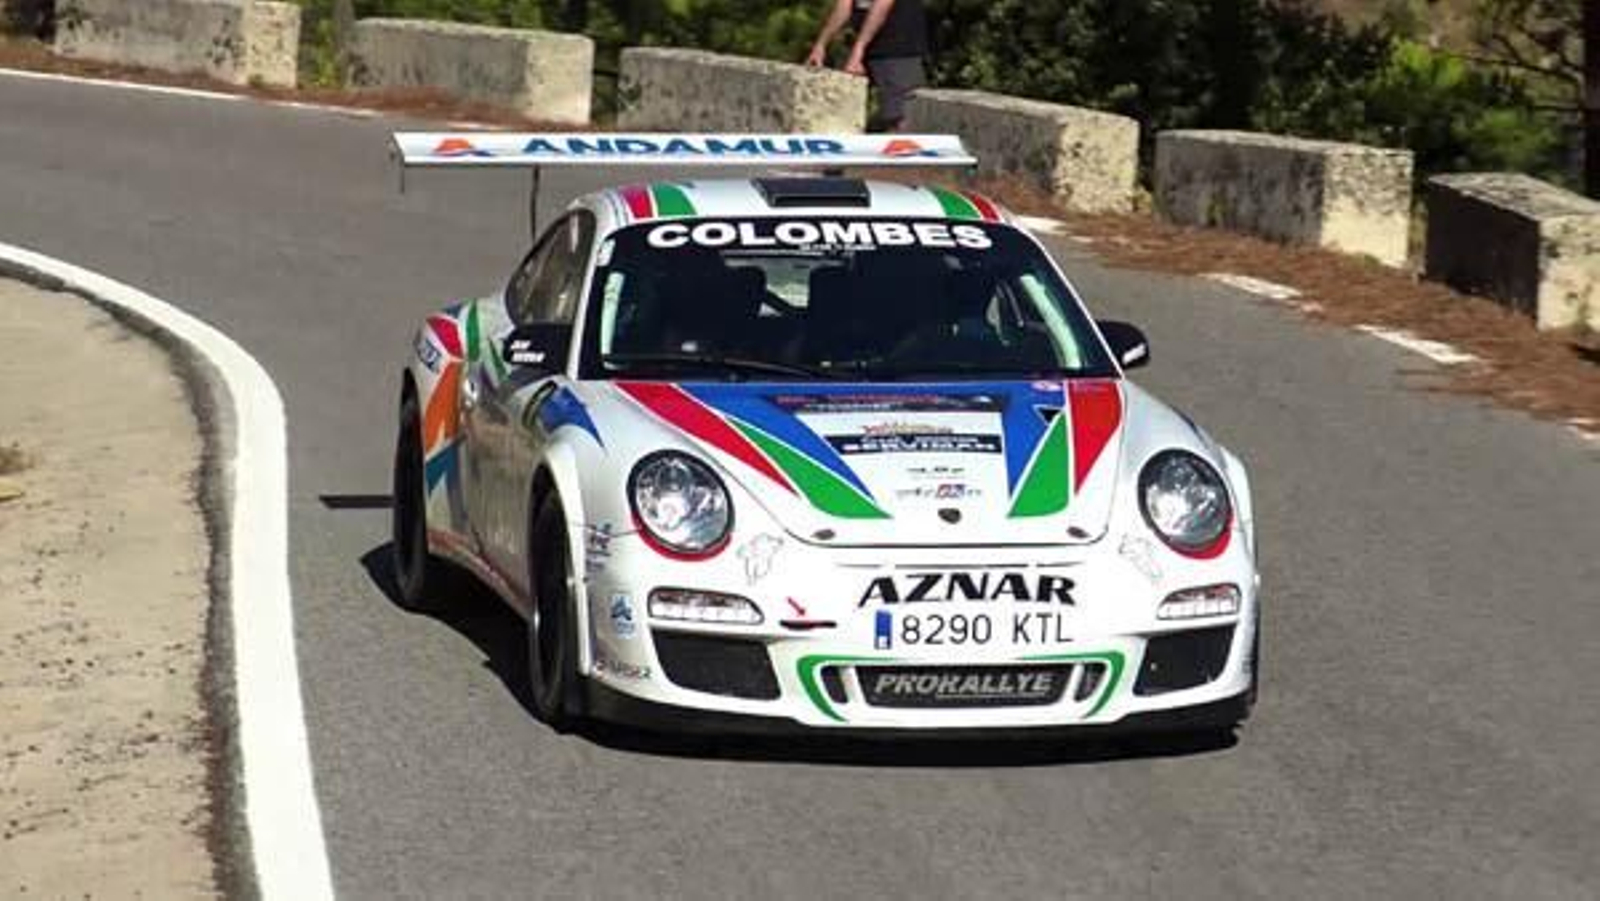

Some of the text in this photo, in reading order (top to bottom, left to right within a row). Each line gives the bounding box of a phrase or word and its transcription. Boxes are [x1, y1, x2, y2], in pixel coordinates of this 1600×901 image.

[523, 138, 845, 154] ANDAMUR
[648, 222, 992, 249] COLOMBES
[858, 572, 1076, 607] AZNAR
[901, 612, 1074, 645] 8290 KTL
